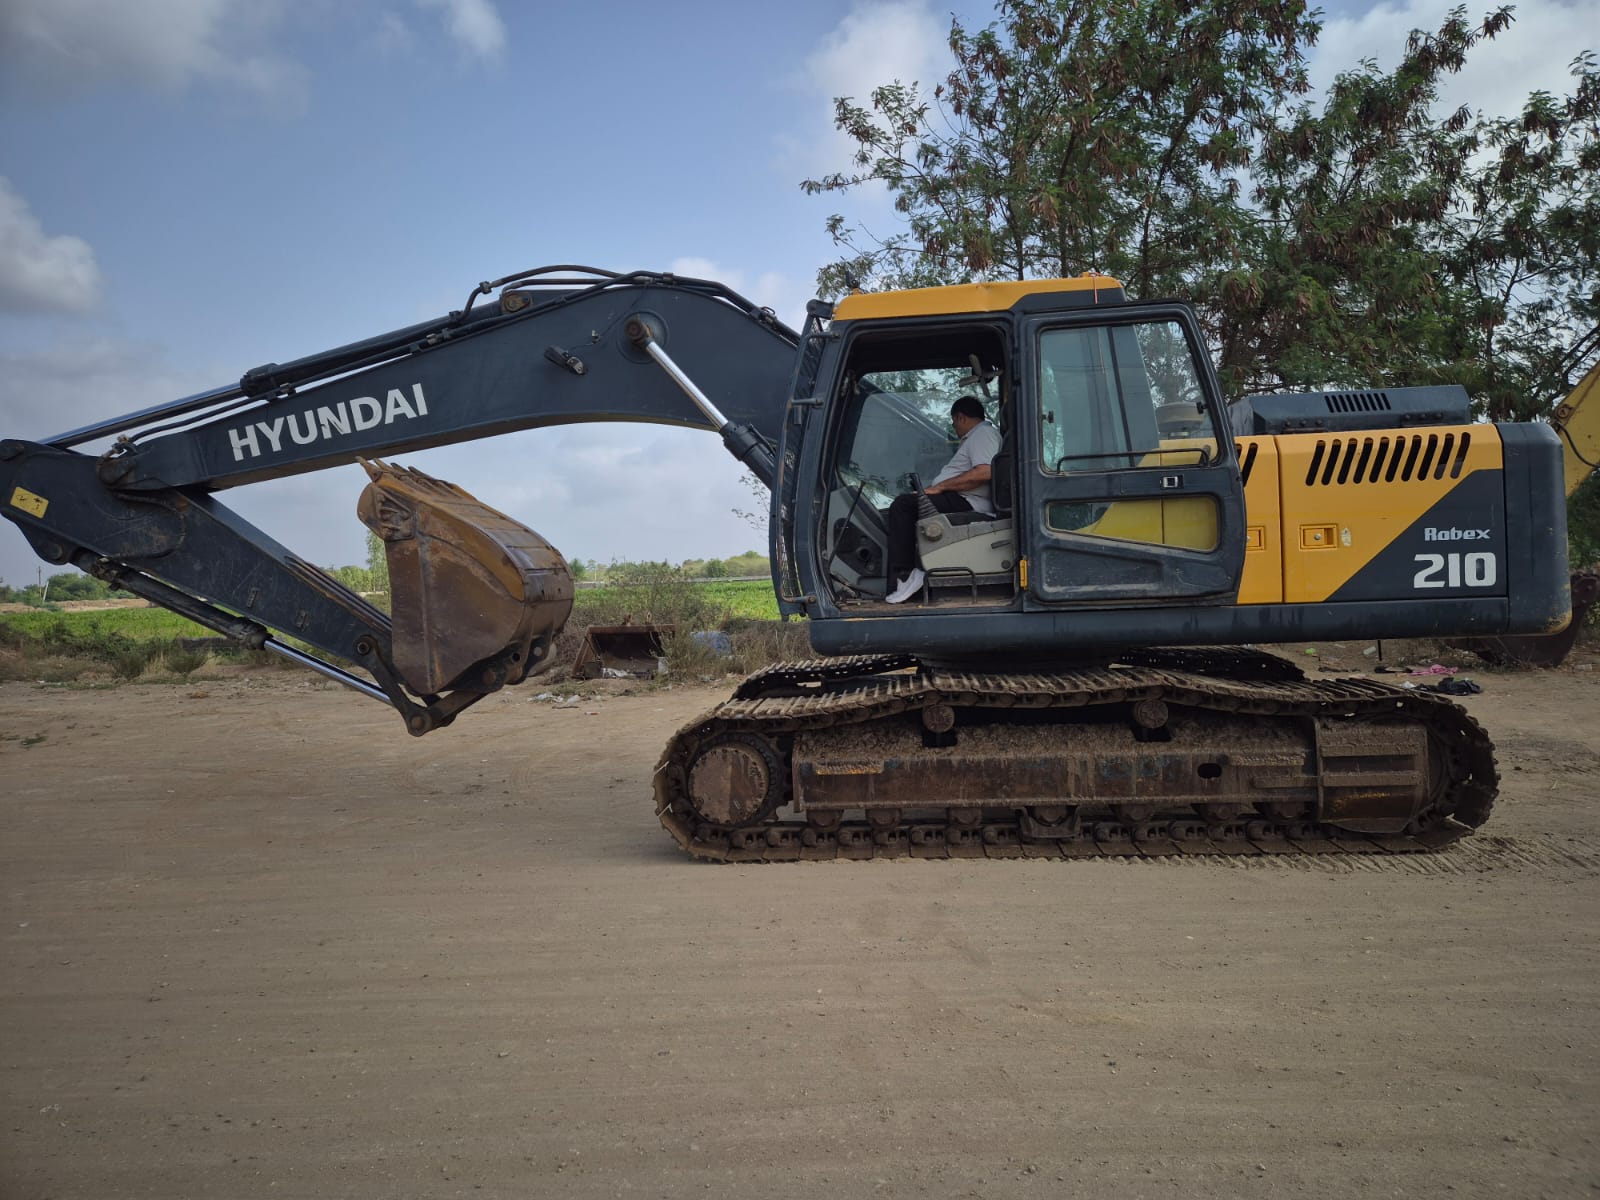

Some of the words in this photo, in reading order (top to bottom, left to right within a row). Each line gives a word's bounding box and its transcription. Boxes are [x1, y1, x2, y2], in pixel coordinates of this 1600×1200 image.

[228, 383, 429, 462] HYUNDAI
[1424, 526, 1490, 541] Robex
[1413, 552, 1497, 588] 210
